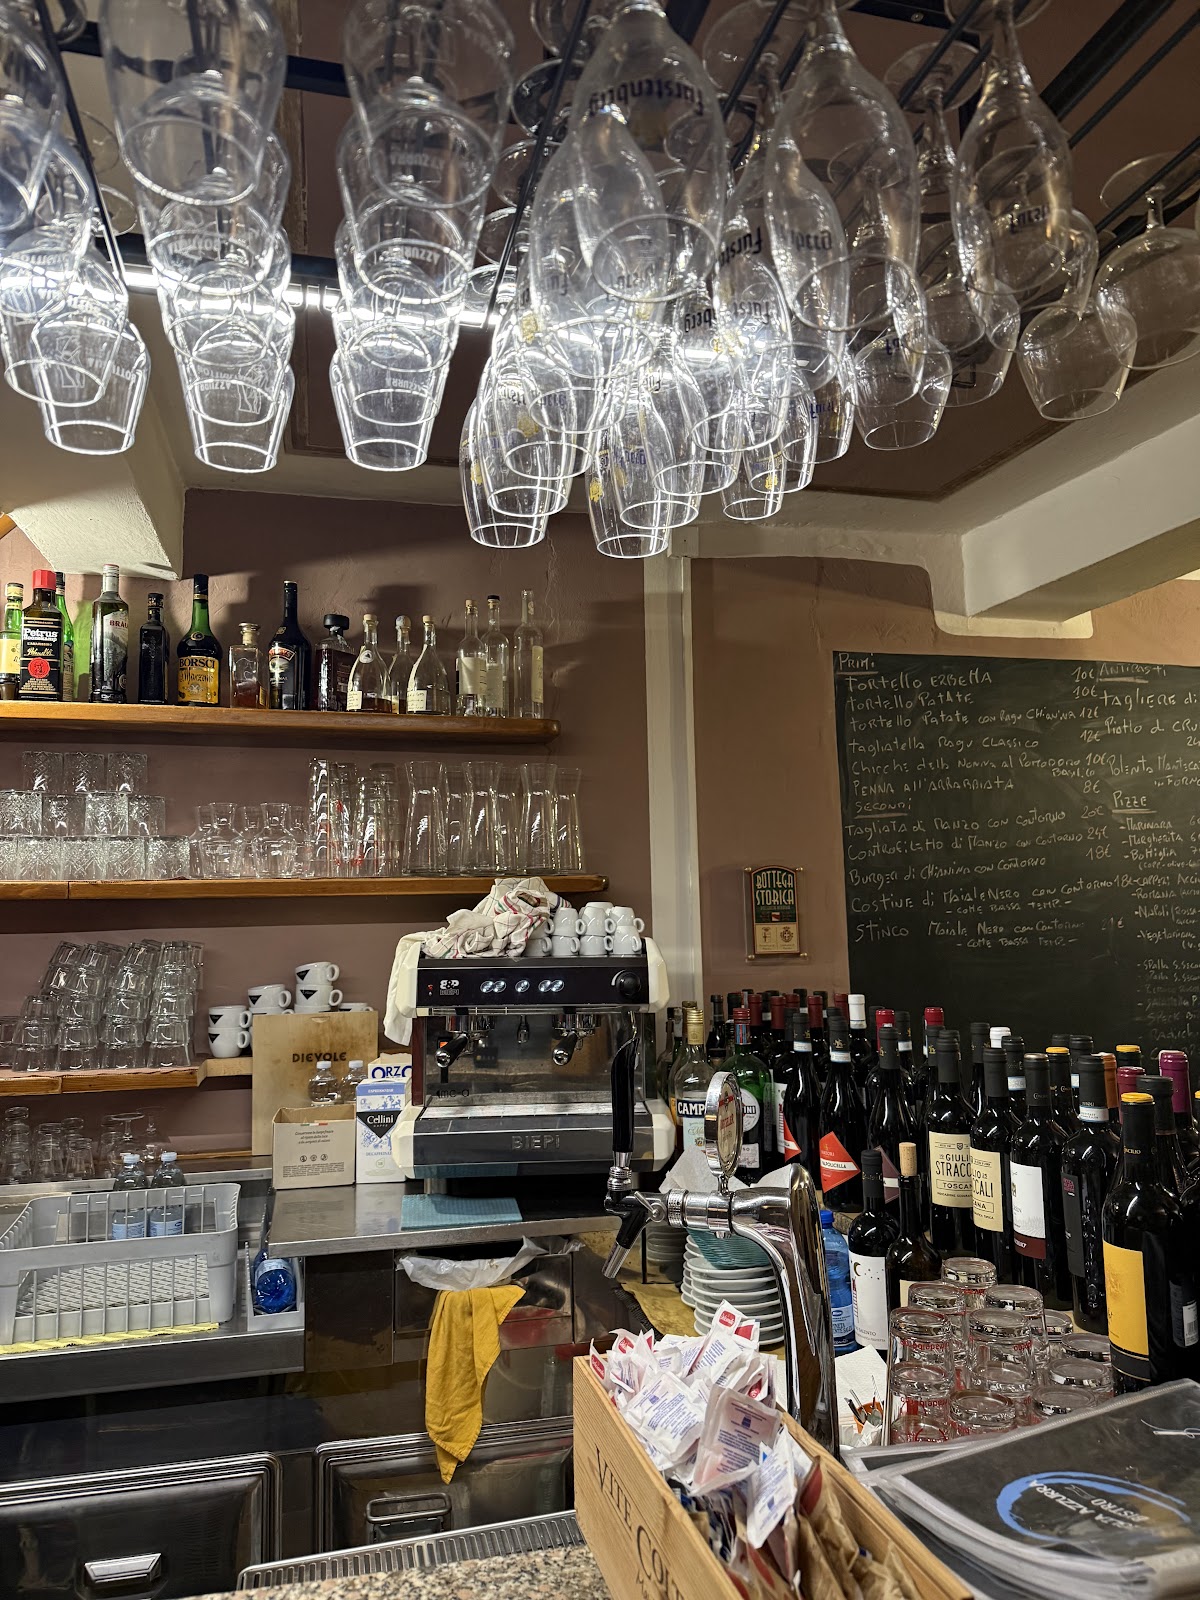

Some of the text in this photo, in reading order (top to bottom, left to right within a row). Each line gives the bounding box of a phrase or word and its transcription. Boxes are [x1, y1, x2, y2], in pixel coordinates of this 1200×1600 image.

[23, 628, 58, 638] Petrus
[179, 658, 215, 668] BORSCI
[853, 780, 895, 797] PENNA
[1083, 780, 1100, 794] 8€
[1112, 790, 1147, 808] PIZZE
[756, 871, 793, 889] BOTTEGA
[756, 889, 794, 905] STORICA
[292, 1052, 347, 1063] DIEVOLE
[367, 1115, 393, 1124] Cellini
[512, 1135, 560, 1149] BIEPI
[594, 1443, 632, 1532] VITE
[1029, 1479, 1096, 1515] AZZURRA
[1091, 1498, 1150, 1522] BISTRO
